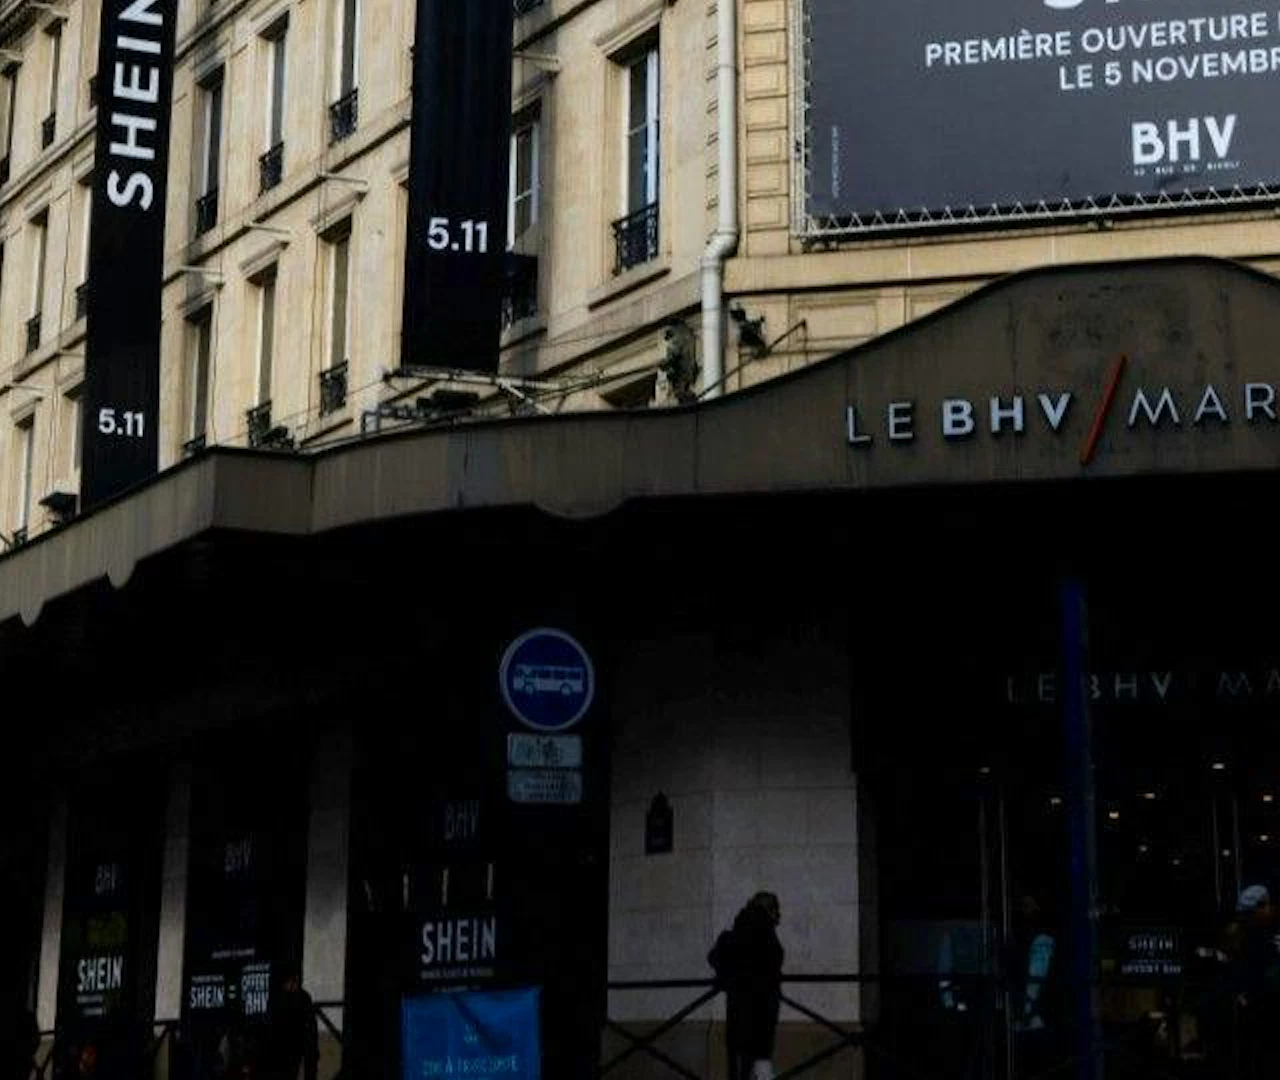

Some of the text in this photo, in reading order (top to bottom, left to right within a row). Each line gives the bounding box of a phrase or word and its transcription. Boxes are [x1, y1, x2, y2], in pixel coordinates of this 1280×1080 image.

[925, 29, 1072, 68] PREMIÈRE
[1081, 11, 1268, 54] OUVERTURE
[1059, 64, 1093, 90] LE
[1104, 61, 1122, 86] 5
[1132, 115, 1236, 165] BHV
[427, 217, 488, 253] 5.11
[98, 408, 144, 437] 5.11
[847, 402, 914, 442] LE
[942, 393, 1070, 435] BHV
[421, 917, 497, 964] SHEIN
[77, 957, 123, 992] SHEIN
[190, 984, 225, 1009] SHEIN
